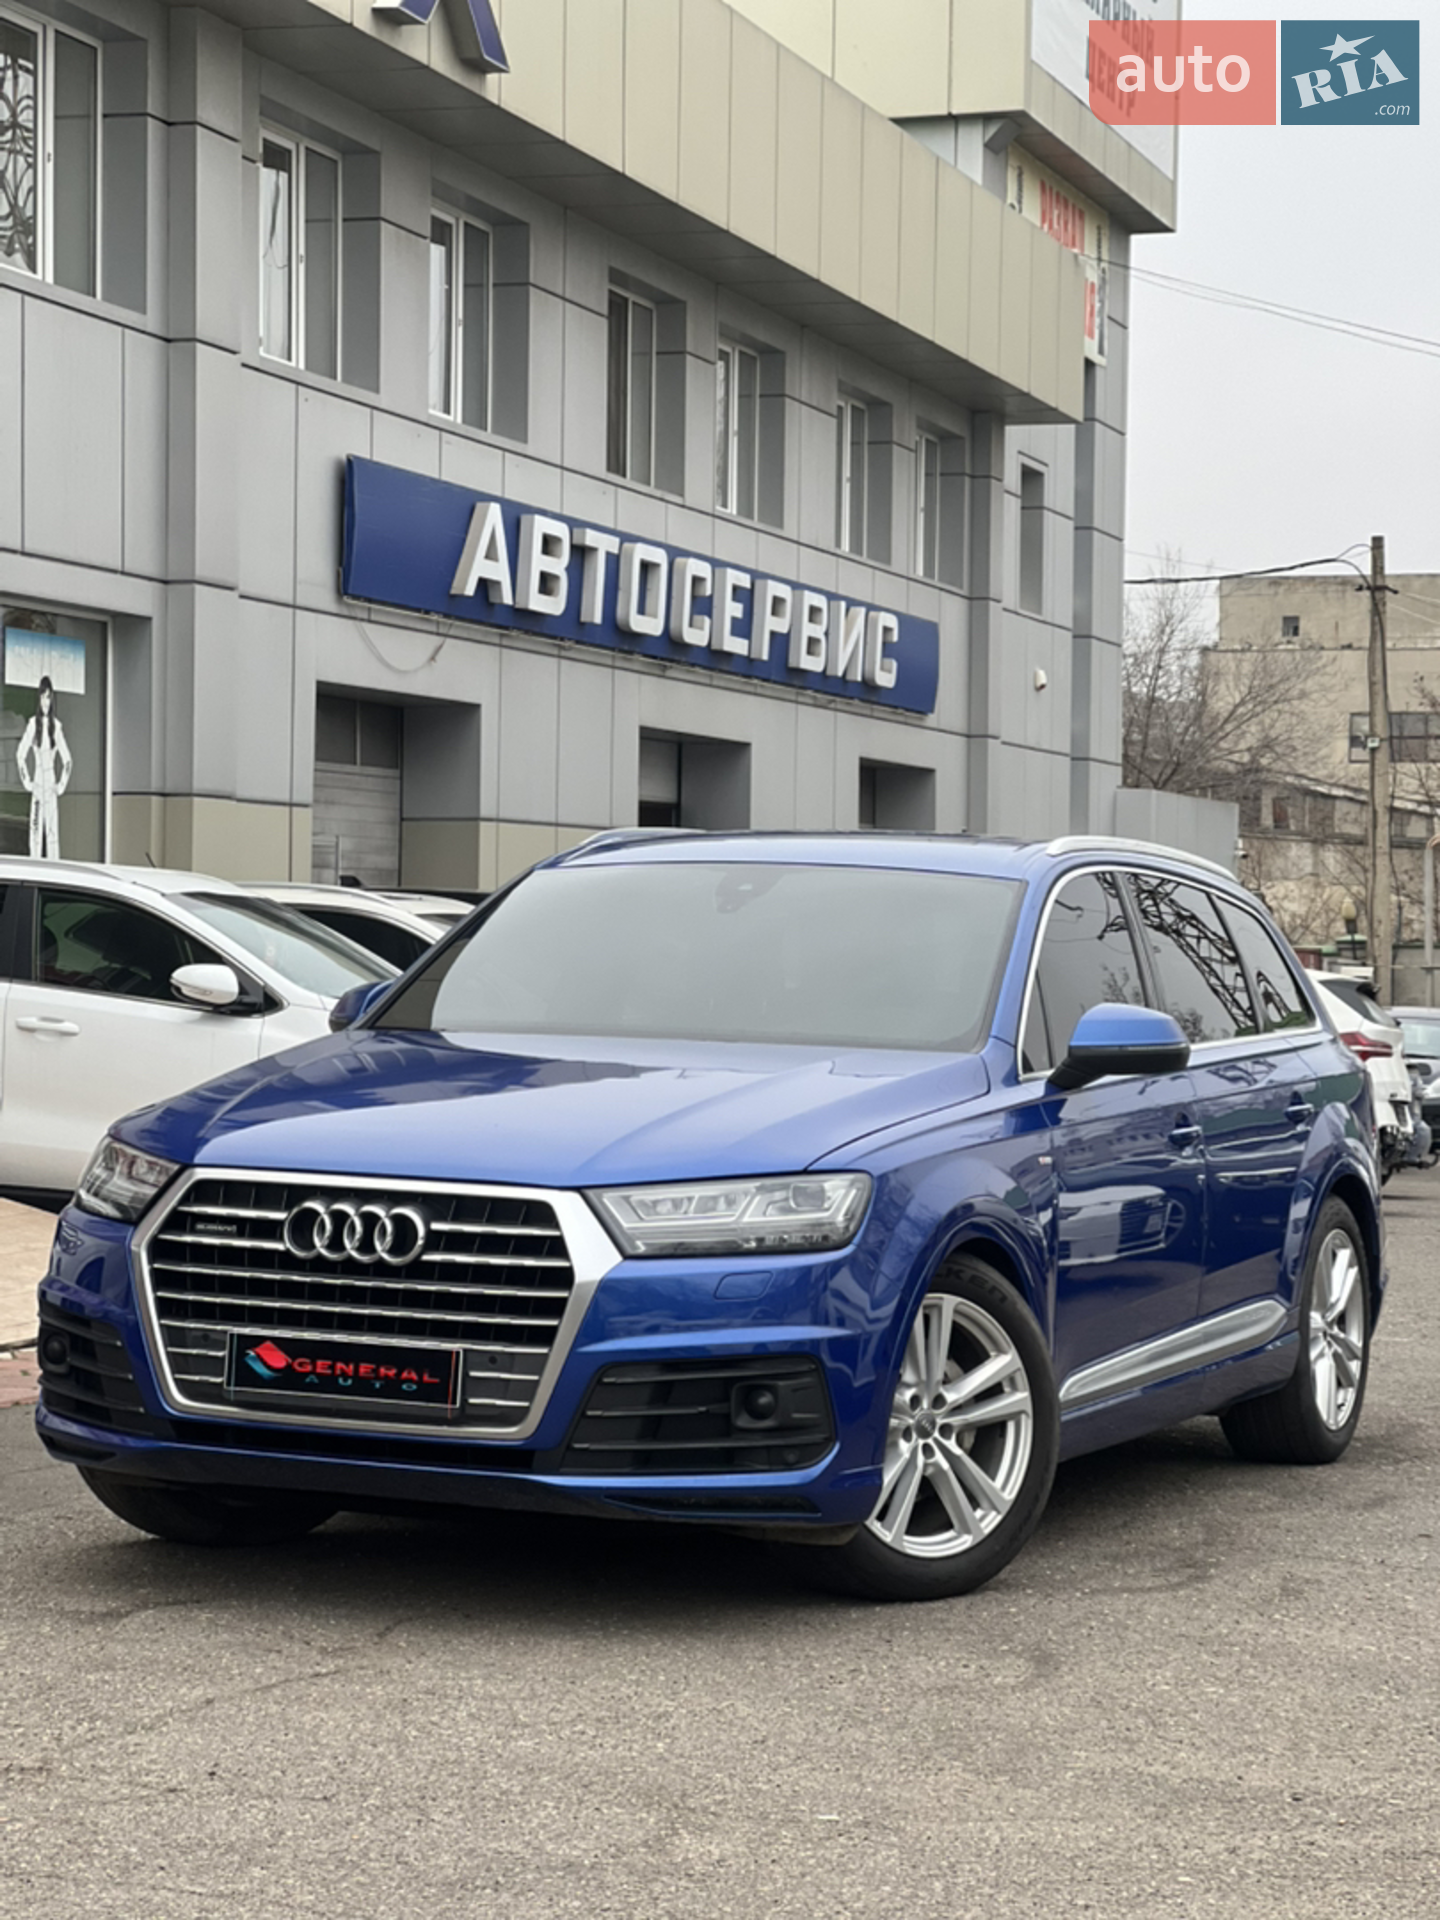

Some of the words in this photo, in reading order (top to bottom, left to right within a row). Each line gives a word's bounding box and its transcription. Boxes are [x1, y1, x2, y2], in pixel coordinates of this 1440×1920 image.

[450, 501, 899, 689] АВТОСЕРВИС
[291, 1357, 441, 1384] GENERAL
[305, 1374, 418, 1392] AUTO
